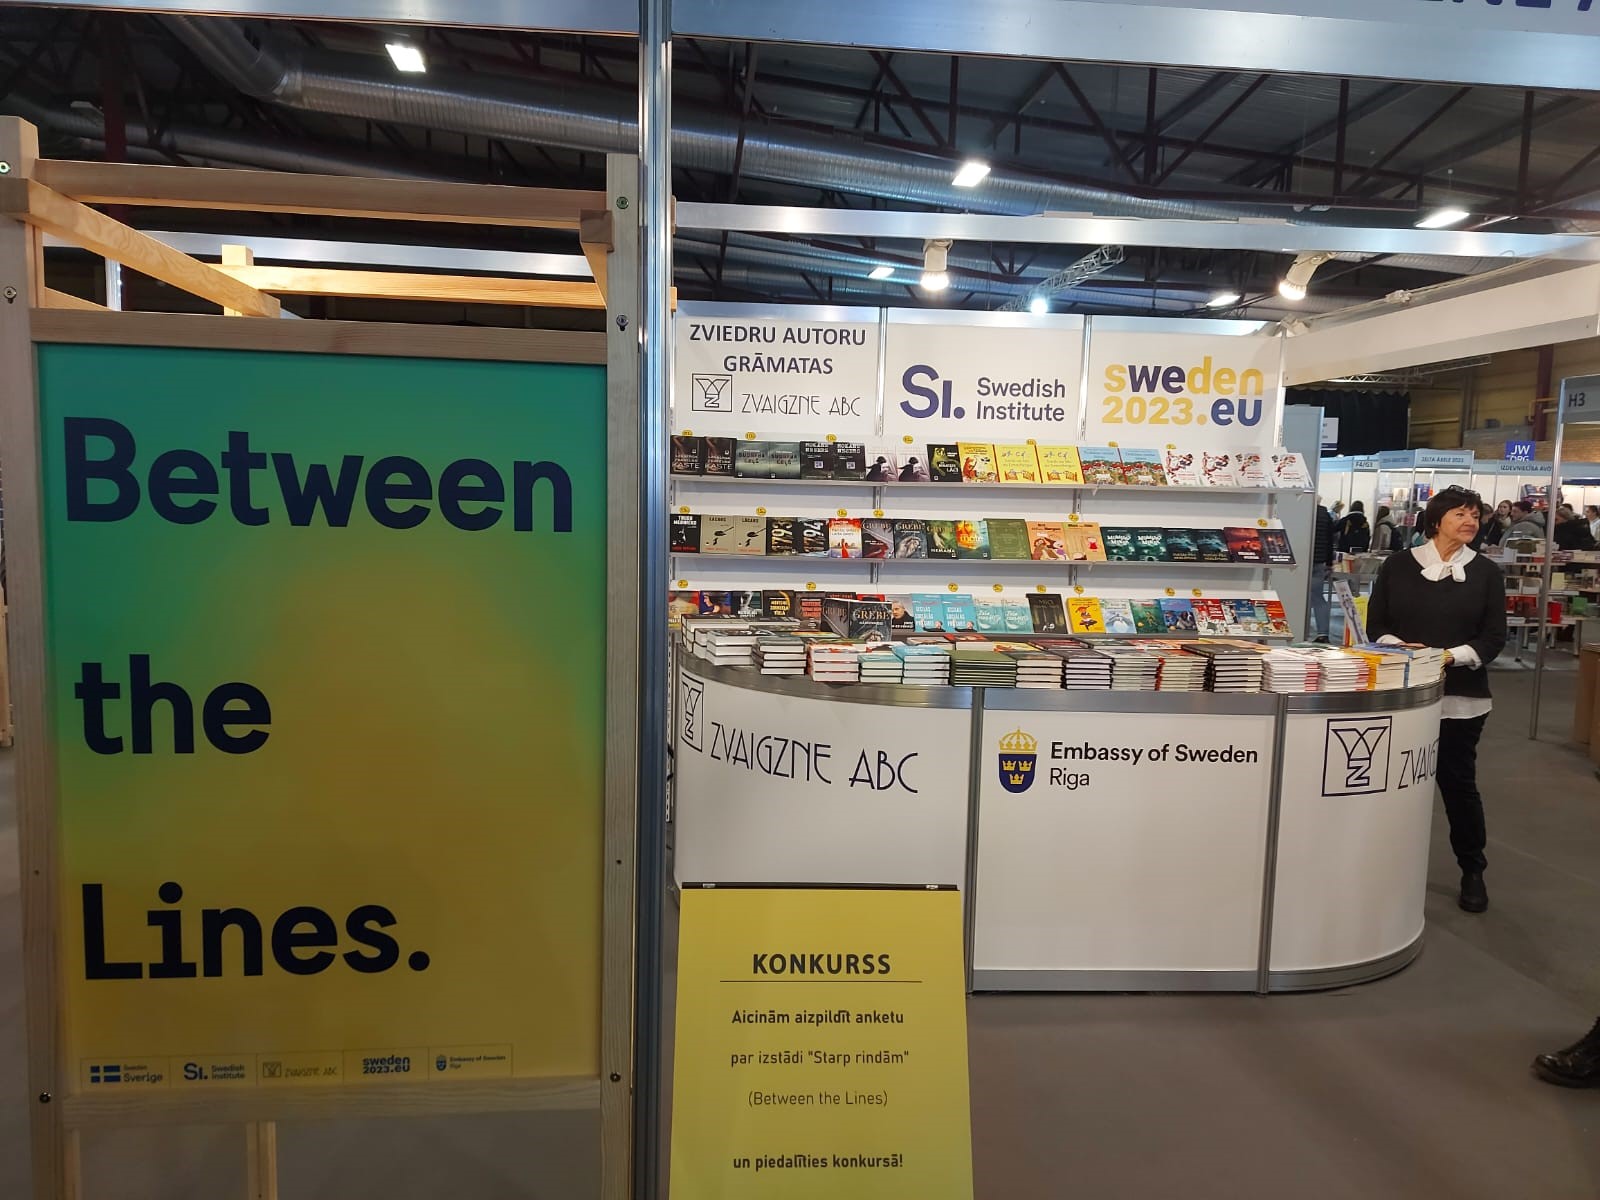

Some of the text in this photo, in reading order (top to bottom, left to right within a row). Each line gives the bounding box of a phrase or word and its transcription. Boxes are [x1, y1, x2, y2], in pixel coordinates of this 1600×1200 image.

[689, 324, 867, 346] ZVIEDRU AUTORU
[723, 352, 834, 375] GRĀMATAS
[1104, 356, 1264, 395] sweden
[976, 376, 1066, 399] Swedish
[741, 393, 862, 417] ZVAIGZNE ABC
[1568, 392, 1586, 407] H3
[976, 401, 1065, 422] Institute
[1102, 395, 1263, 427] 2023.eu
[1510, 444, 1531, 455] JW
[63, 416, 573, 533] Between
[74, 653, 272, 755] the
[710, 721, 919, 794] ZVAIGZNE ABC
[1050, 741, 1258, 767] Embassy of Sweden
[1398, 737, 1439, 790] ZVAIG
[1050, 767, 1090, 790] Riga
[82, 881, 431, 980] Lines.
[752, 953, 892, 975] KONKURSS
[731, 1009, 904, 1027] Aicinām aizpildīt anketu
[362, 1054, 411, 1066] sweden
[362, 1063, 411, 1075] 2023.eu
[730, 1050, 909, 1068] par izstādi "Starp rindām"
[123, 1073, 163, 1085] Sverige
[748, 1091, 888, 1107] (Between the Lines)
[733, 1154, 904, 1172] un piedalīties konkursā!
